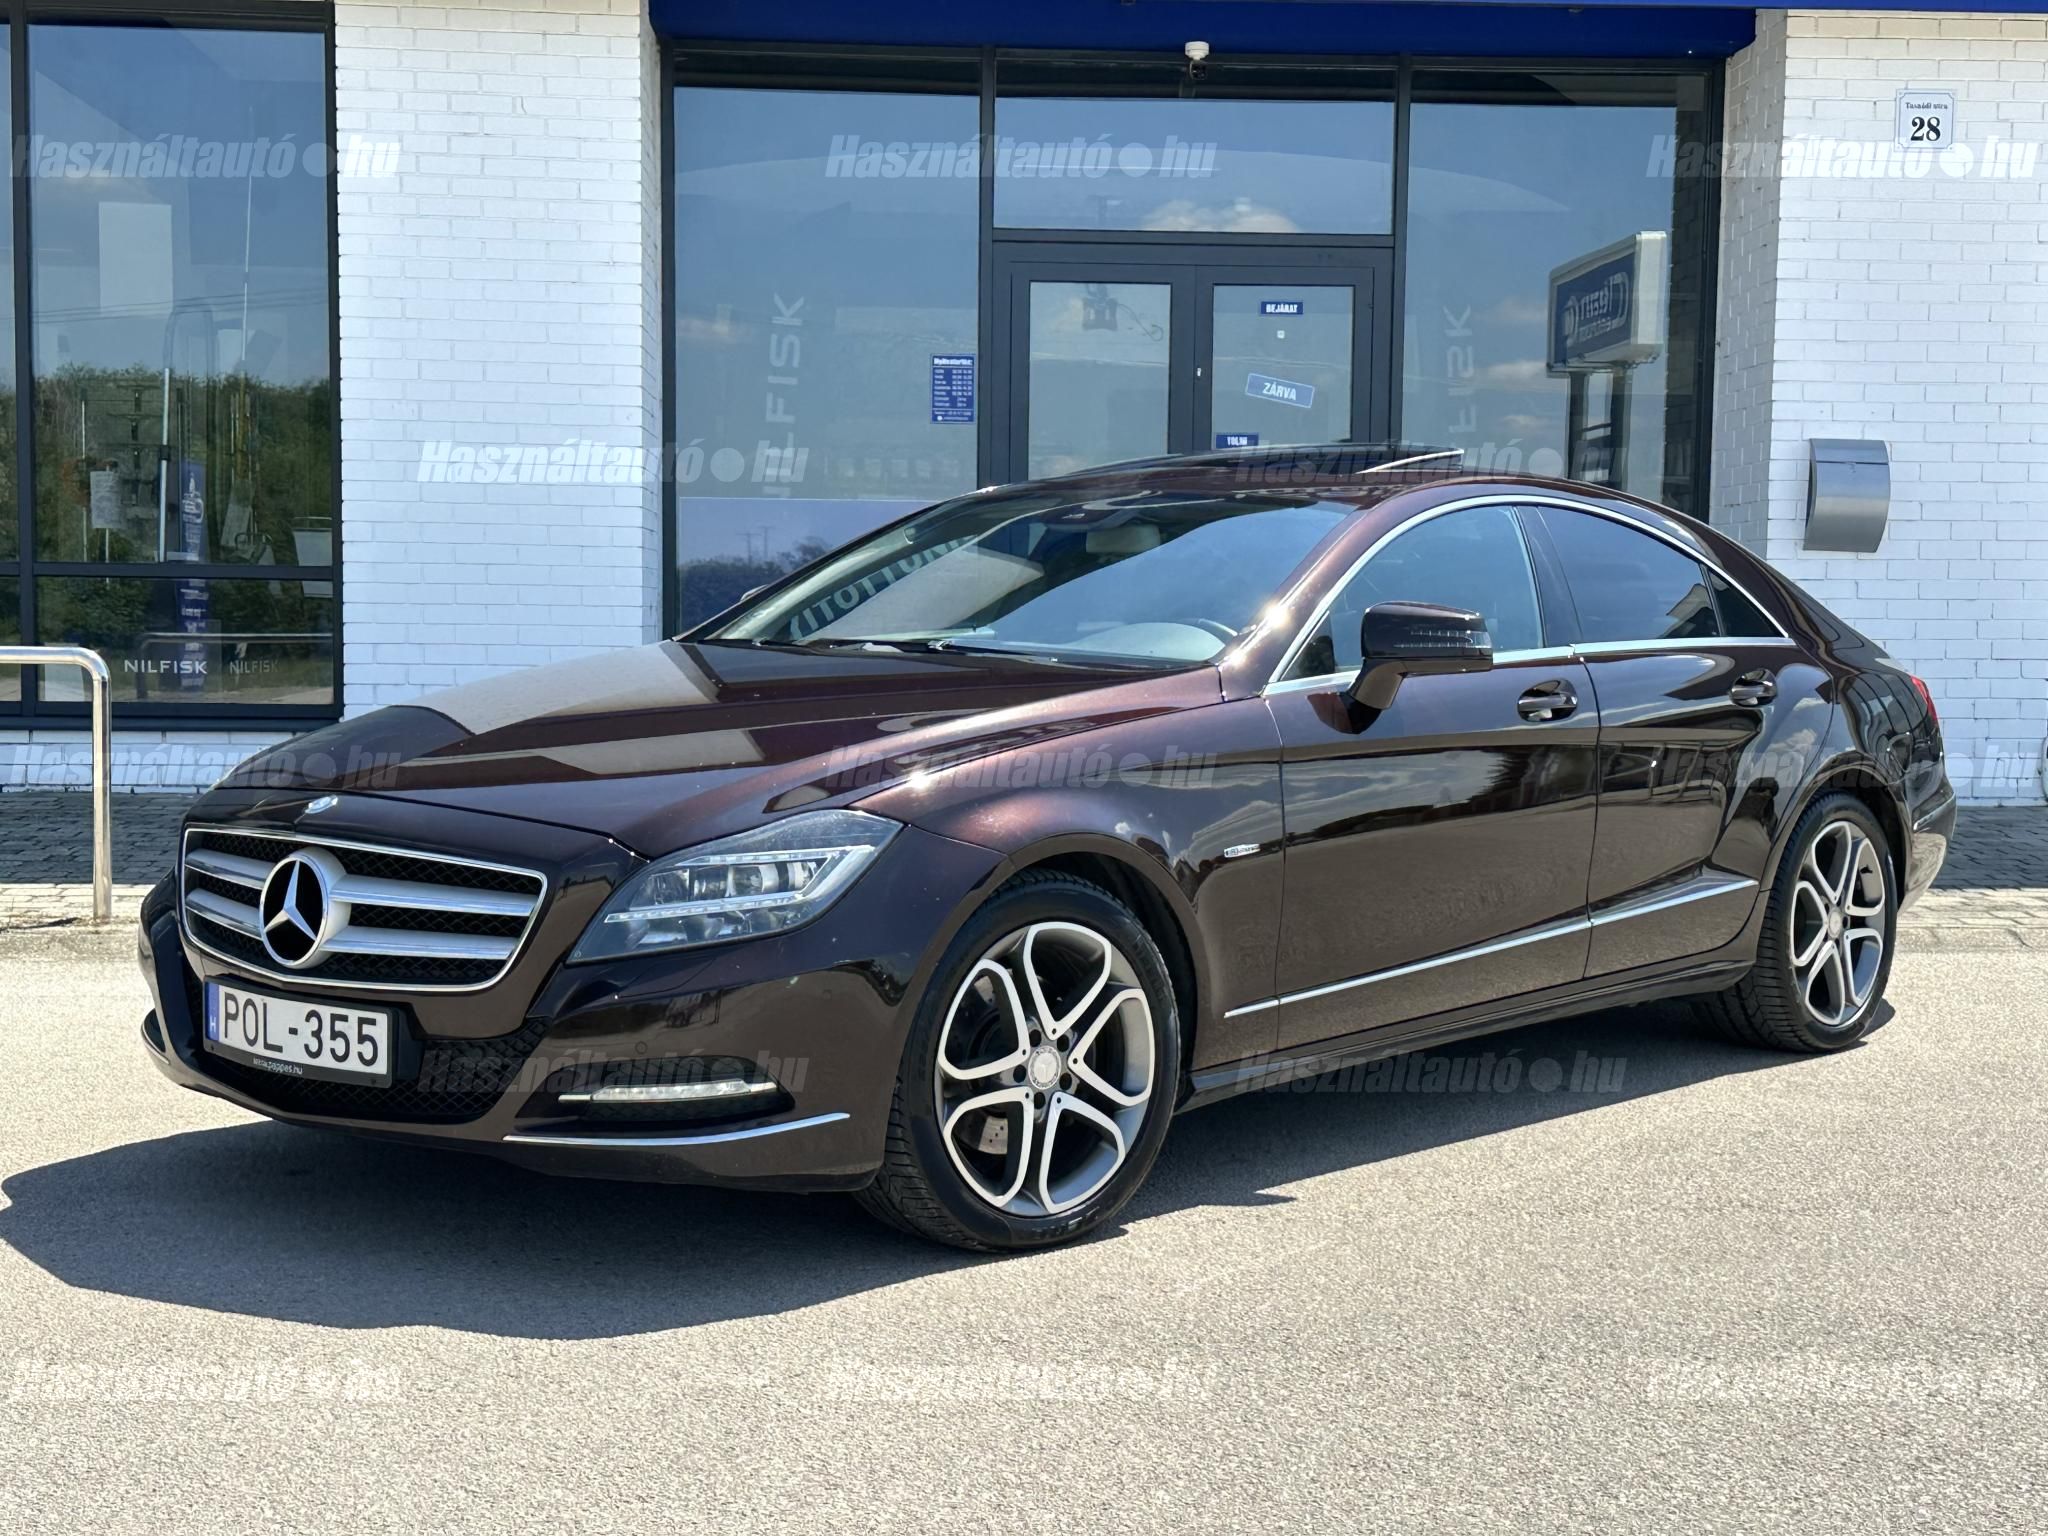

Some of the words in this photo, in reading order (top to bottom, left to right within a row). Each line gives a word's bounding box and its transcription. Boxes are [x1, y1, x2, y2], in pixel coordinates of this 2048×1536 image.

[1911, 116, 1941, 141] 28
[1262, 381, 1297, 401] ZÁRVA
[124, 659, 208, 675] NILFISK
[229, 659, 279, 674] NILFISK
[210, 1016, 217, 1032] H
[224, 992, 379, 1067] POL-355
